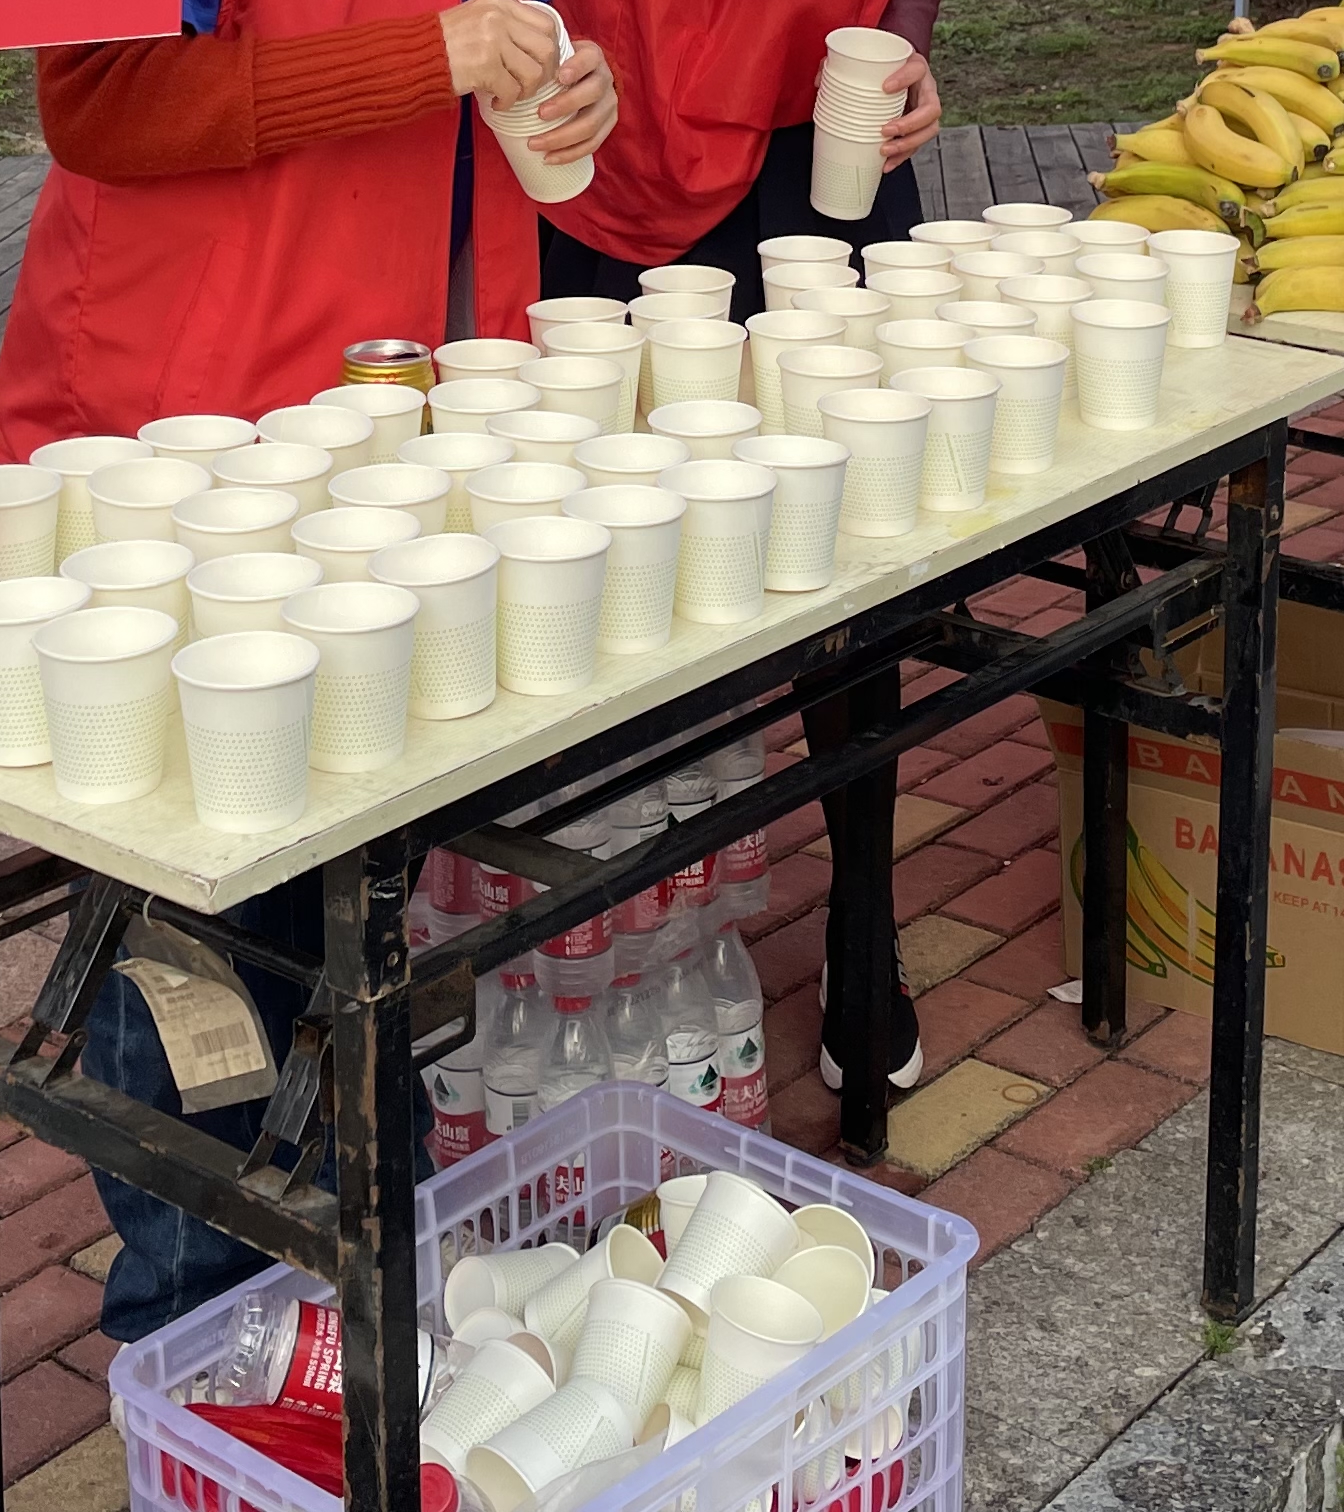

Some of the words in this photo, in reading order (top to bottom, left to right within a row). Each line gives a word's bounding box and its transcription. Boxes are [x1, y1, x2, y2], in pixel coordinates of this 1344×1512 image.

[1272, 891, 1309, 909] KEEP
[1312, 901, 1330, 915] AT
[313, 1347, 334, 1390] SPRING
